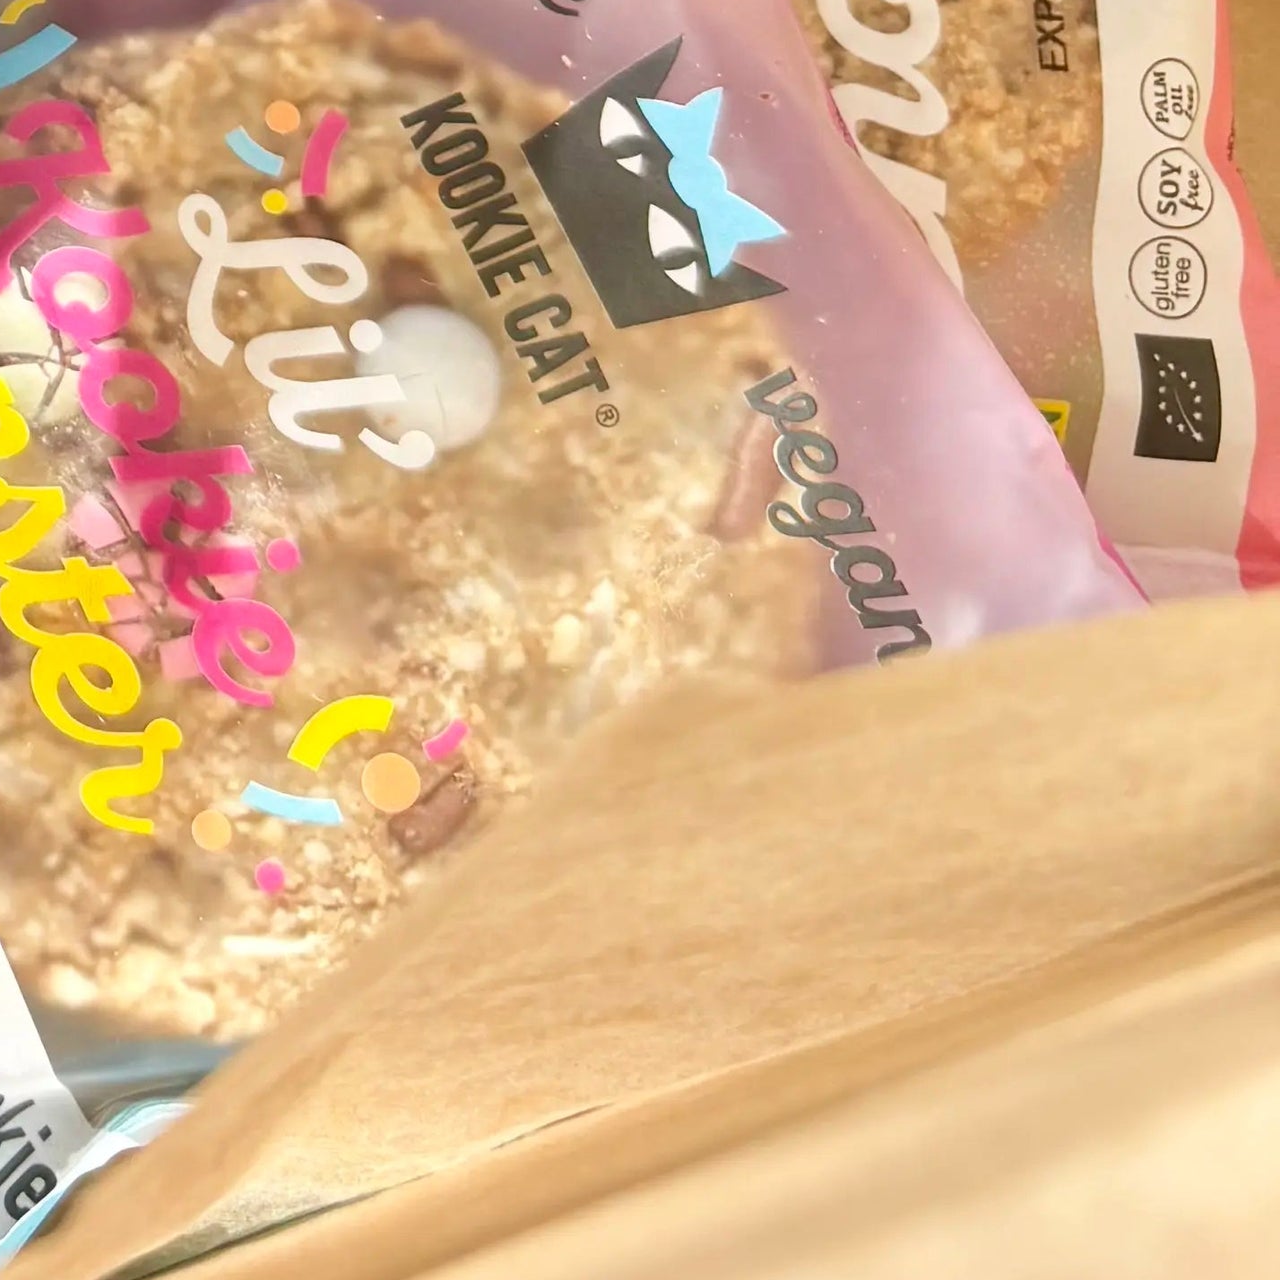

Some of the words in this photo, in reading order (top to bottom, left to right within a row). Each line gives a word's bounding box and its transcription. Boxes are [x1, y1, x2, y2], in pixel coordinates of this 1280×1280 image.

[1153, 70, 1170, 125] PALM
[1170, 84, 1183, 116] OIL
[398, 90, 550, 300] KOOKIE
[1157, 158, 1182, 217] SOY
[1180, 169, 1205, 212] free
[1151, 241, 1176, 312] gluten
[1174, 256, 1192, 300] free
[741, 364, 933, 668] vegan
